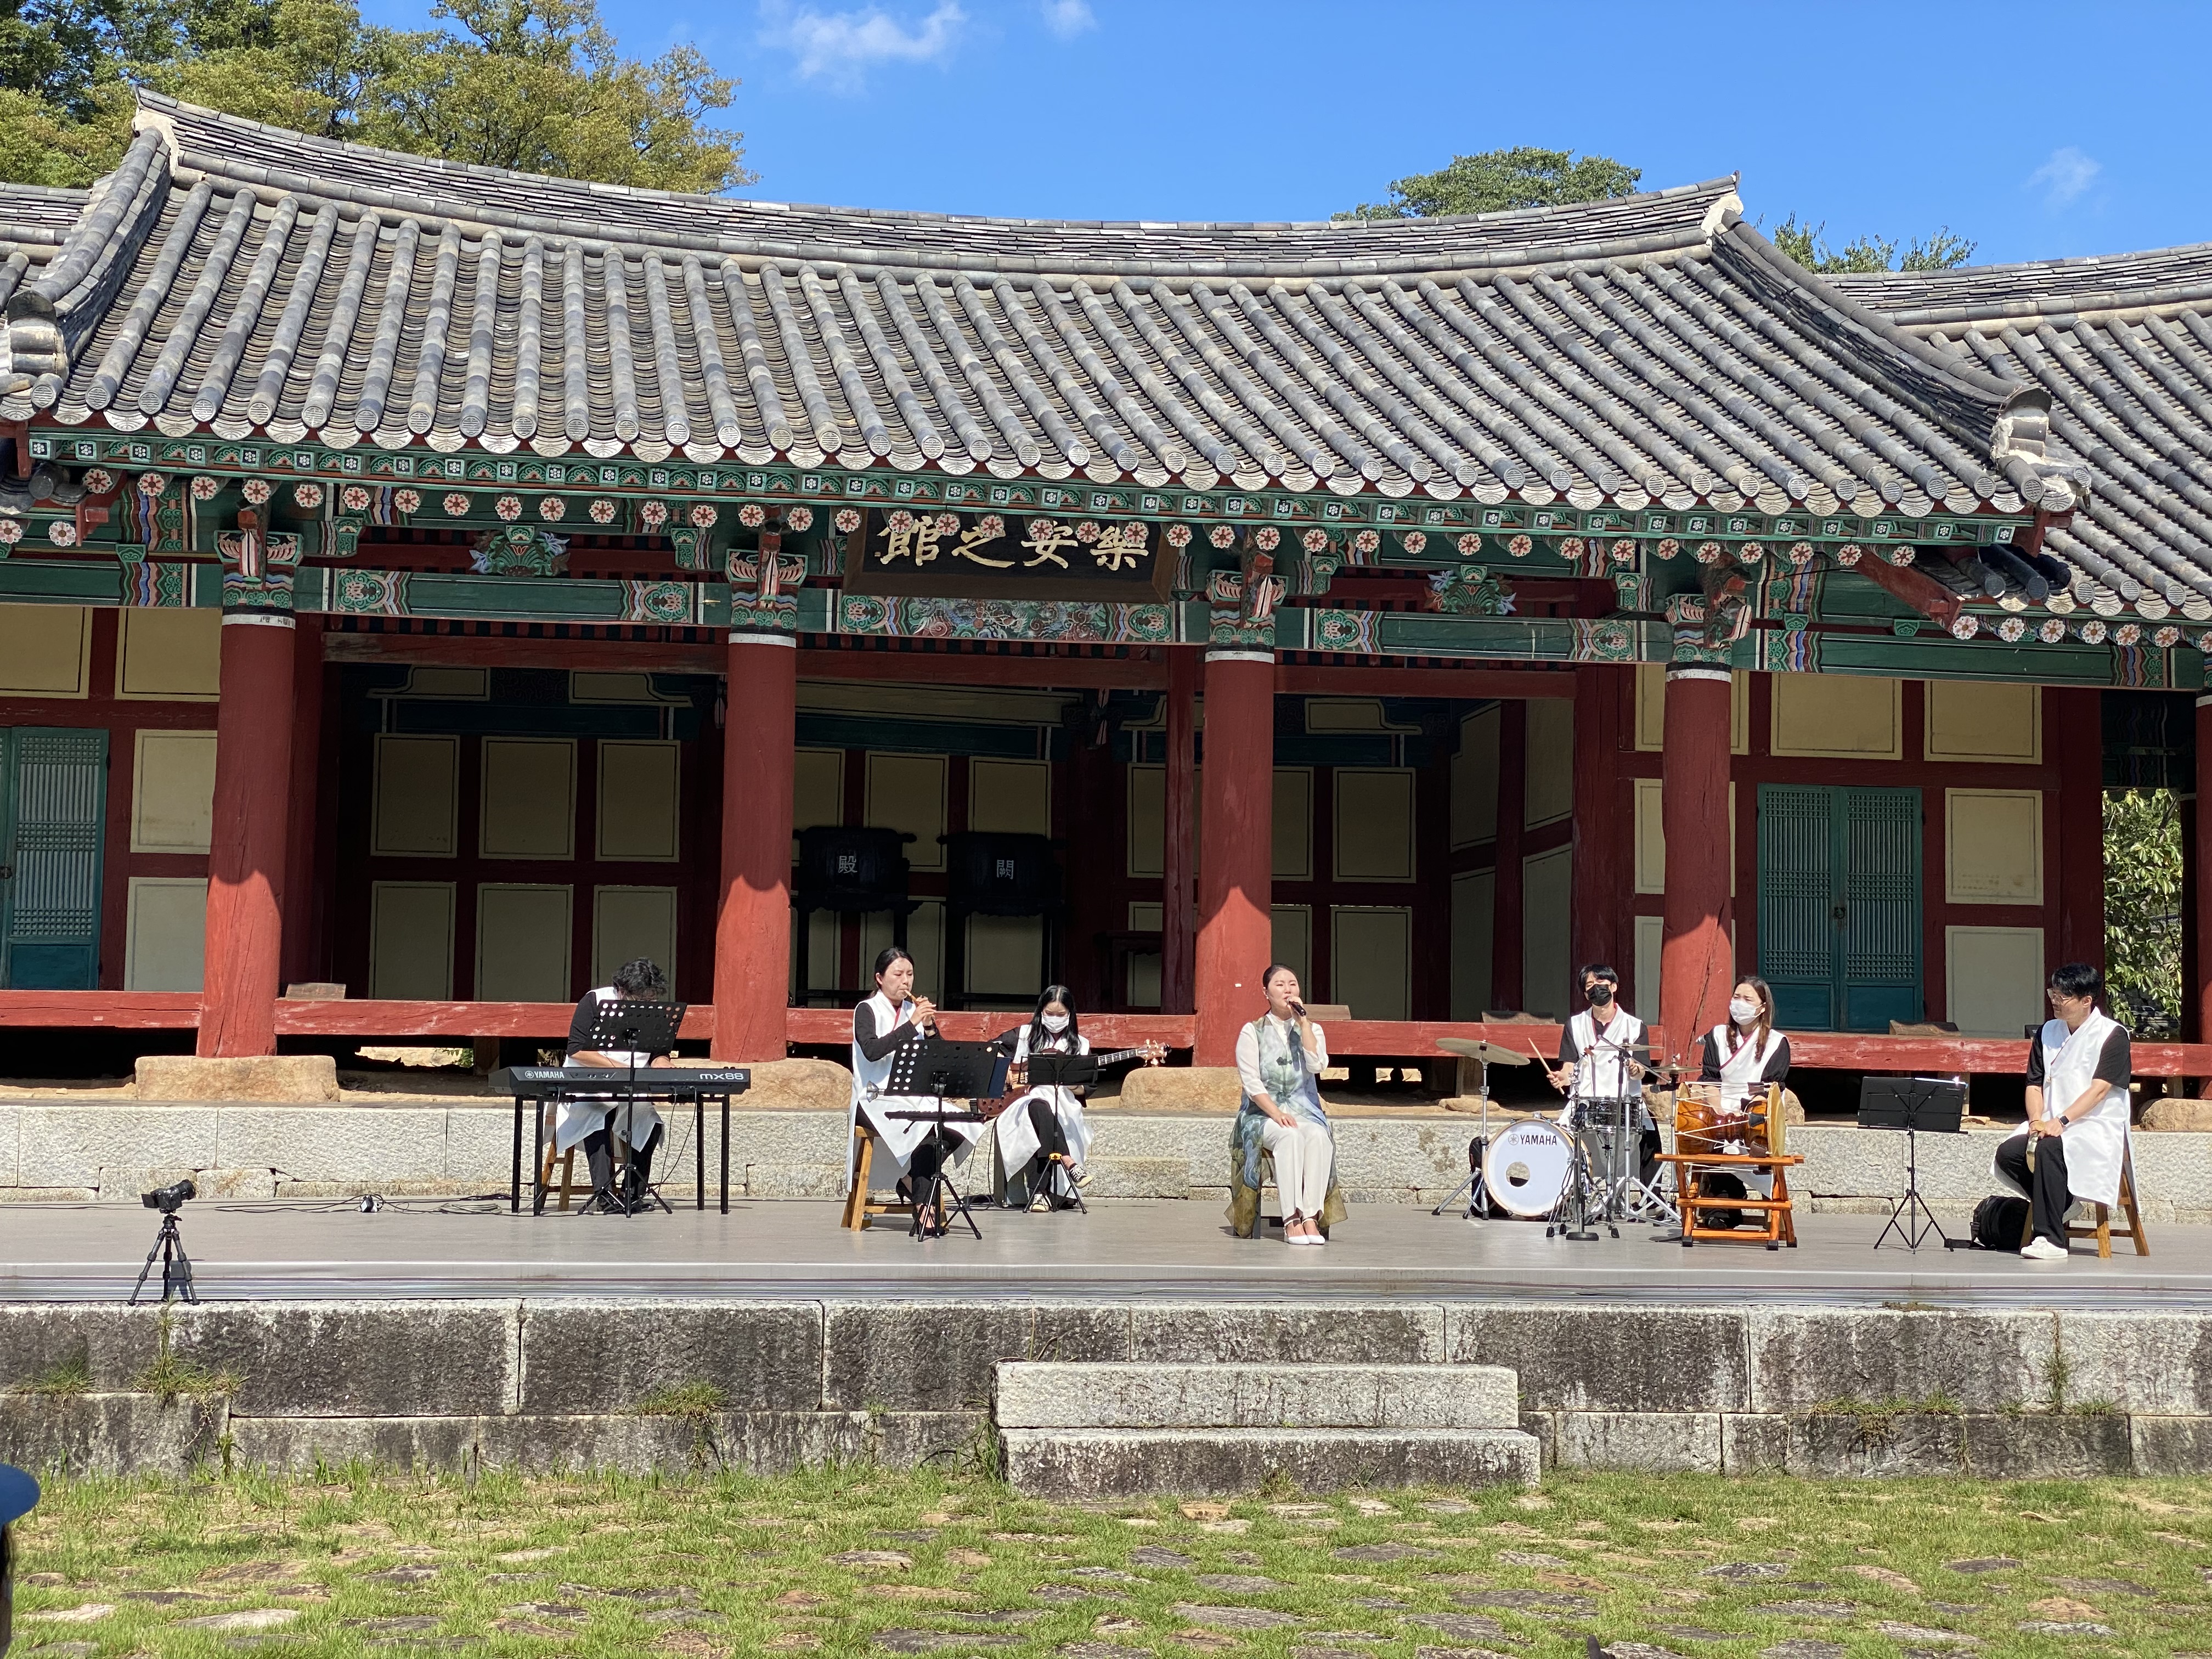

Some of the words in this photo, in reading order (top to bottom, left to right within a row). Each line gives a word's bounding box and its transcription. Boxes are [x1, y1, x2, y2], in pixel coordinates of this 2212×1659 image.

[838, 855, 857, 874] 殿
[996, 859, 1014, 880] 闕
[1520, 1135, 1557, 1146] YAMAHA
